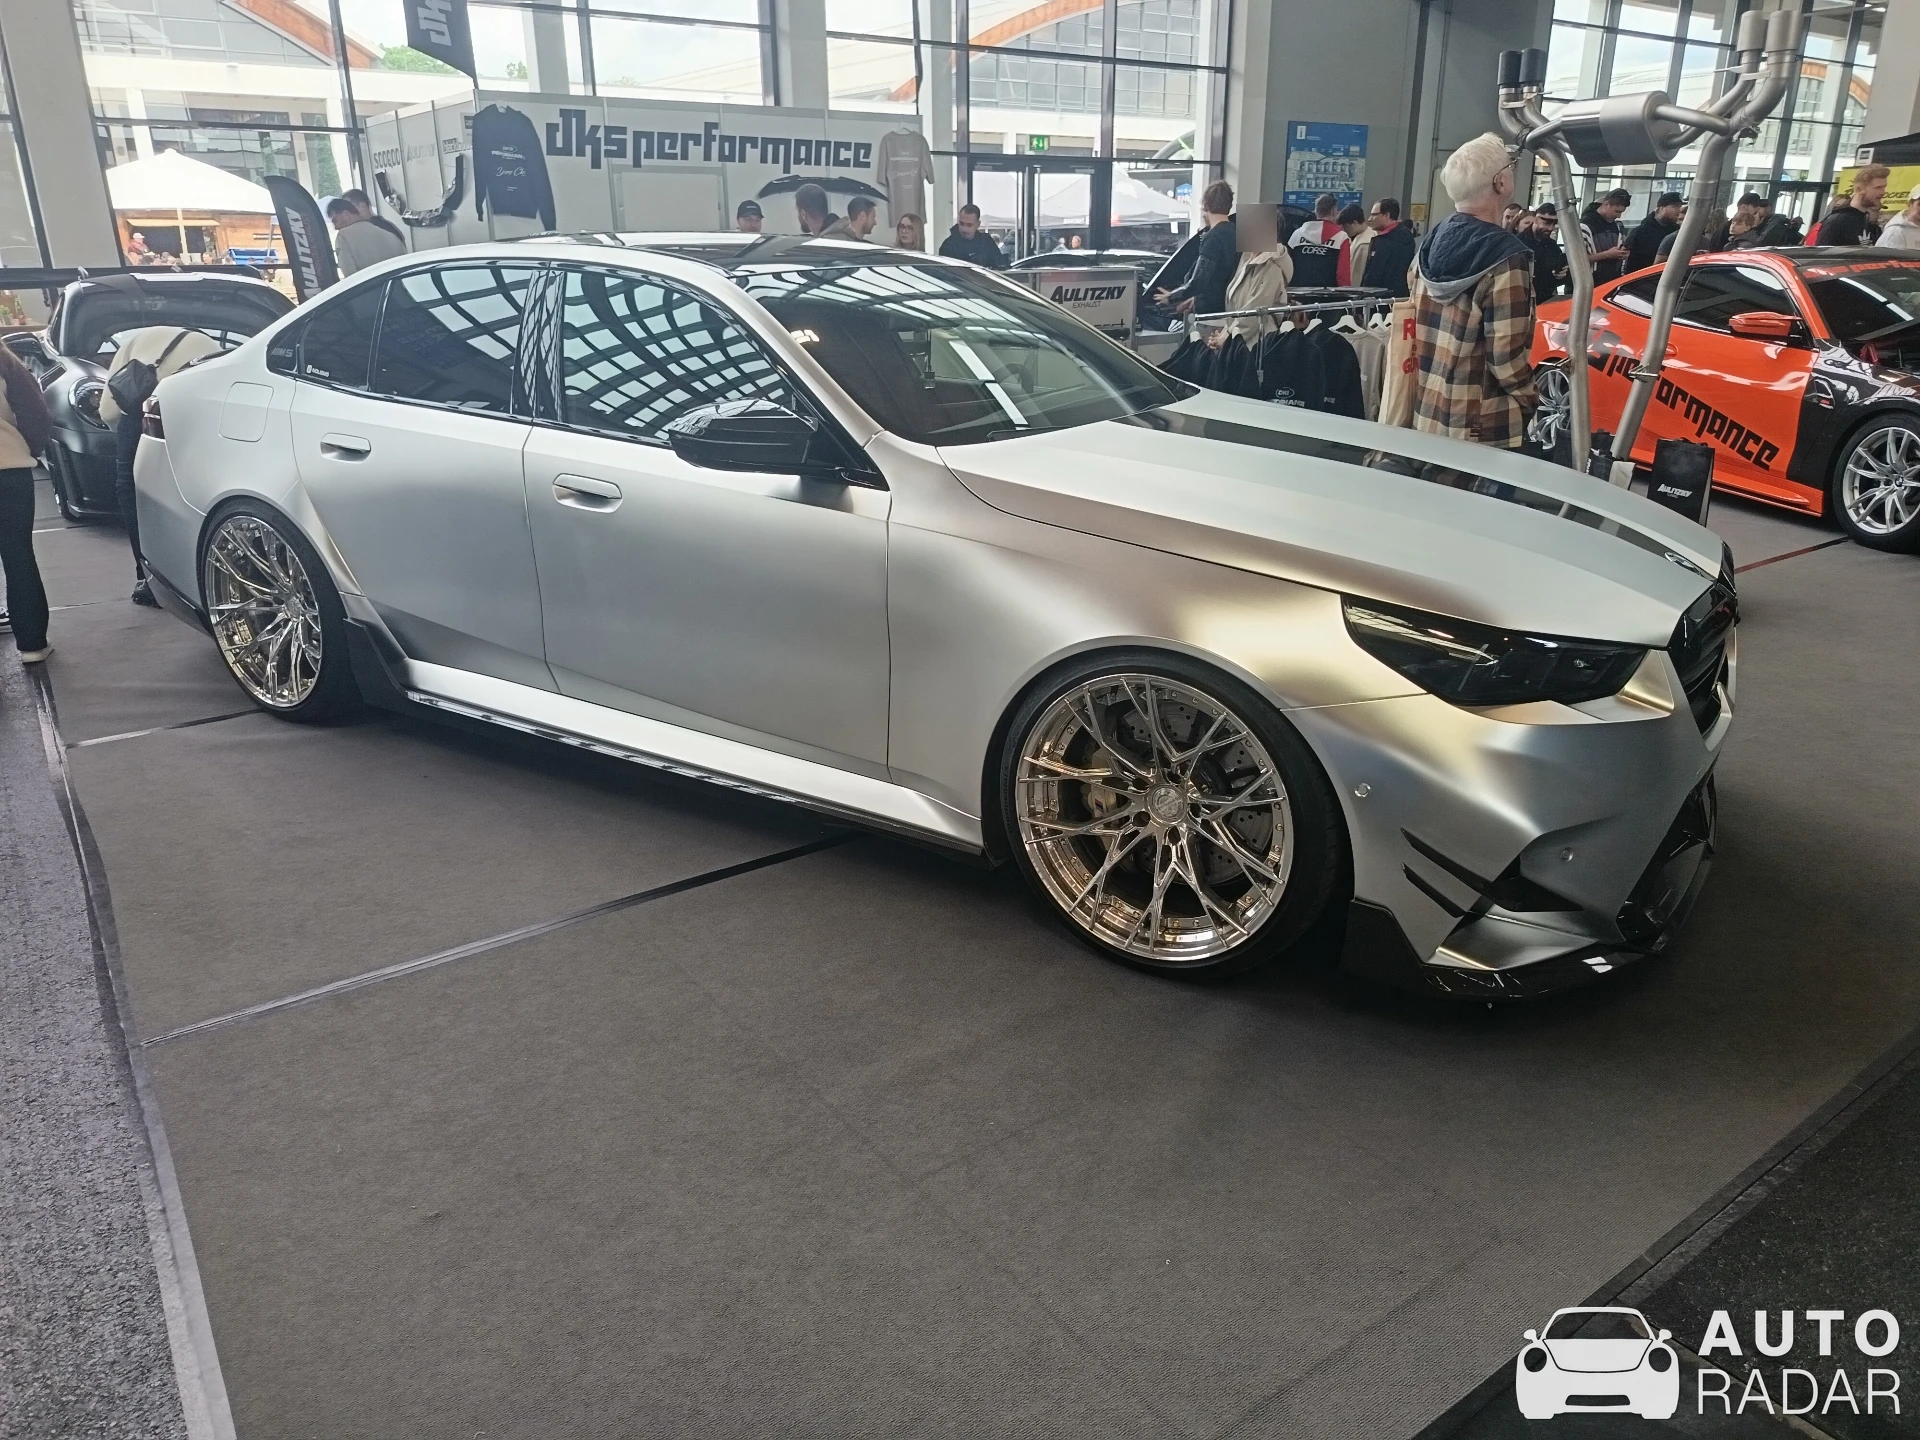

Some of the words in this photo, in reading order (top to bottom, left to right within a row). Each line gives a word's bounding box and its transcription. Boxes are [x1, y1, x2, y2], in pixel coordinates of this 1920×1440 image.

[1302, 246, 1328, 256] CORSE
[1050, 285, 1127, 305] AULITZKY
[1072, 300, 1102, 309] EXHAUST
